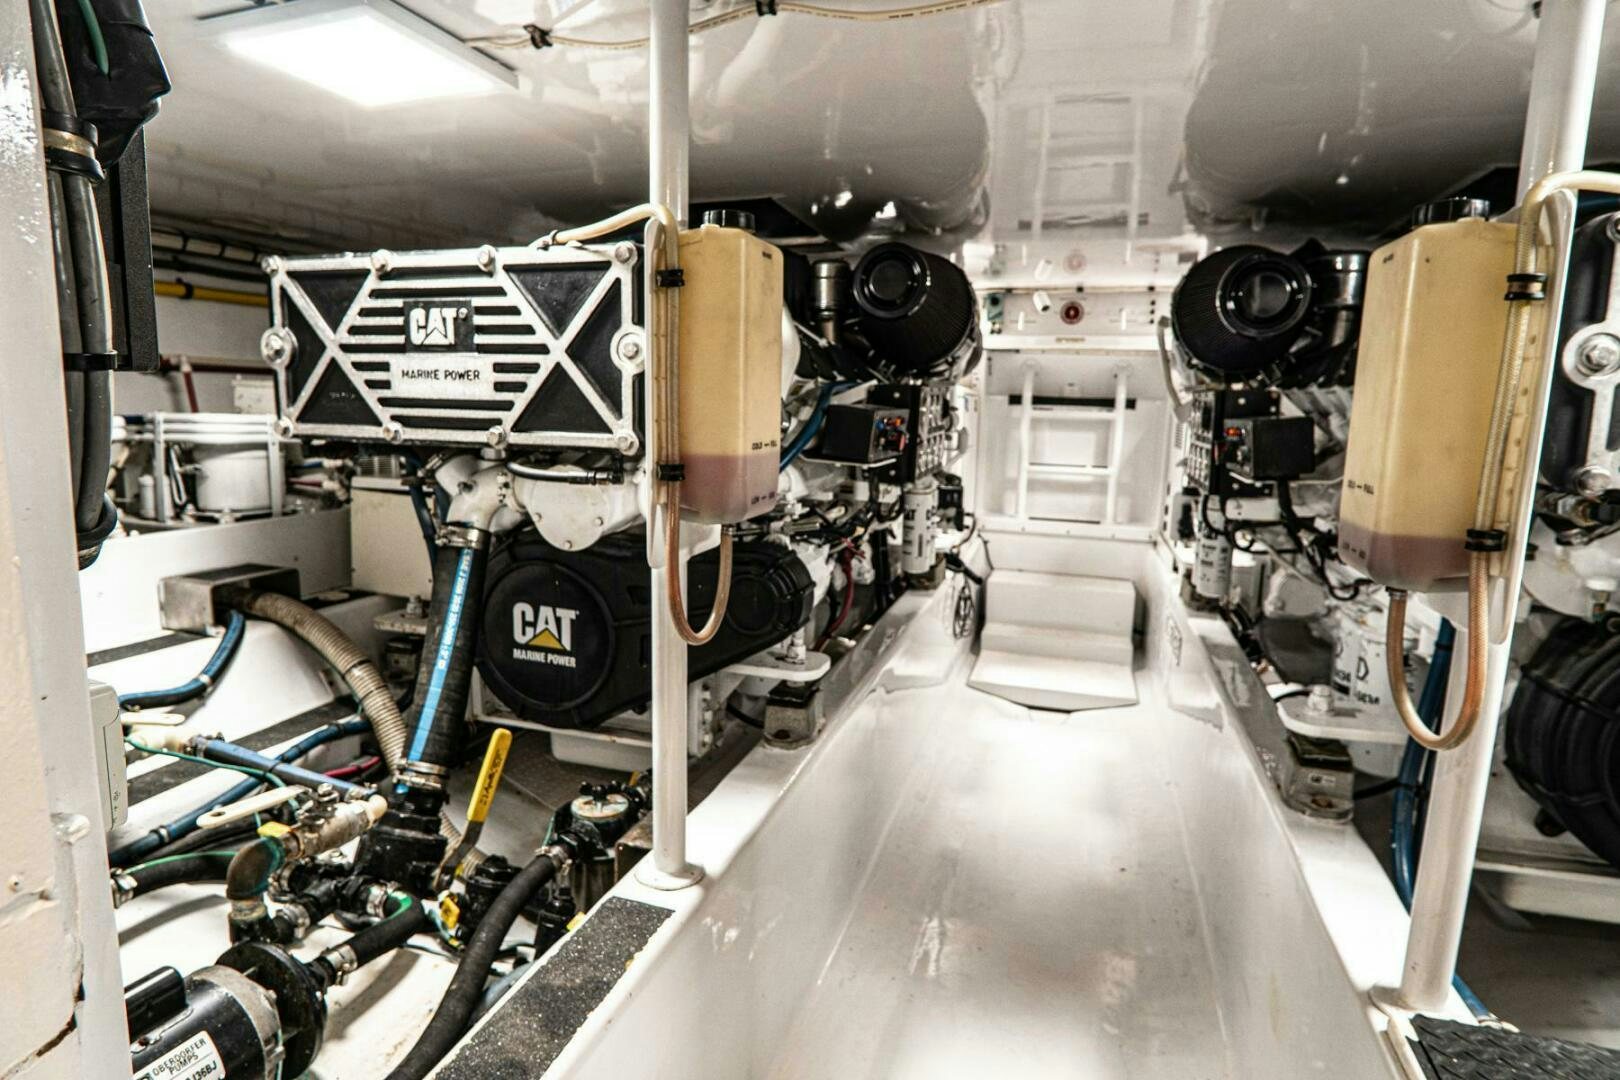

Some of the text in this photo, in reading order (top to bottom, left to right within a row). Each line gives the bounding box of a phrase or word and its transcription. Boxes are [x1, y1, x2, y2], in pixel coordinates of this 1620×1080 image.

[409, 307, 458, 346] CAT
[401, 369, 480, 381] MARINE POWER
[512, 601, 576, 651] CAT
[512, 647, 577, 669] MARINE POWER
[152, 1038, 207, 1076] OBERDORFER
[168, 1052, 199, 1075] PUMPS
